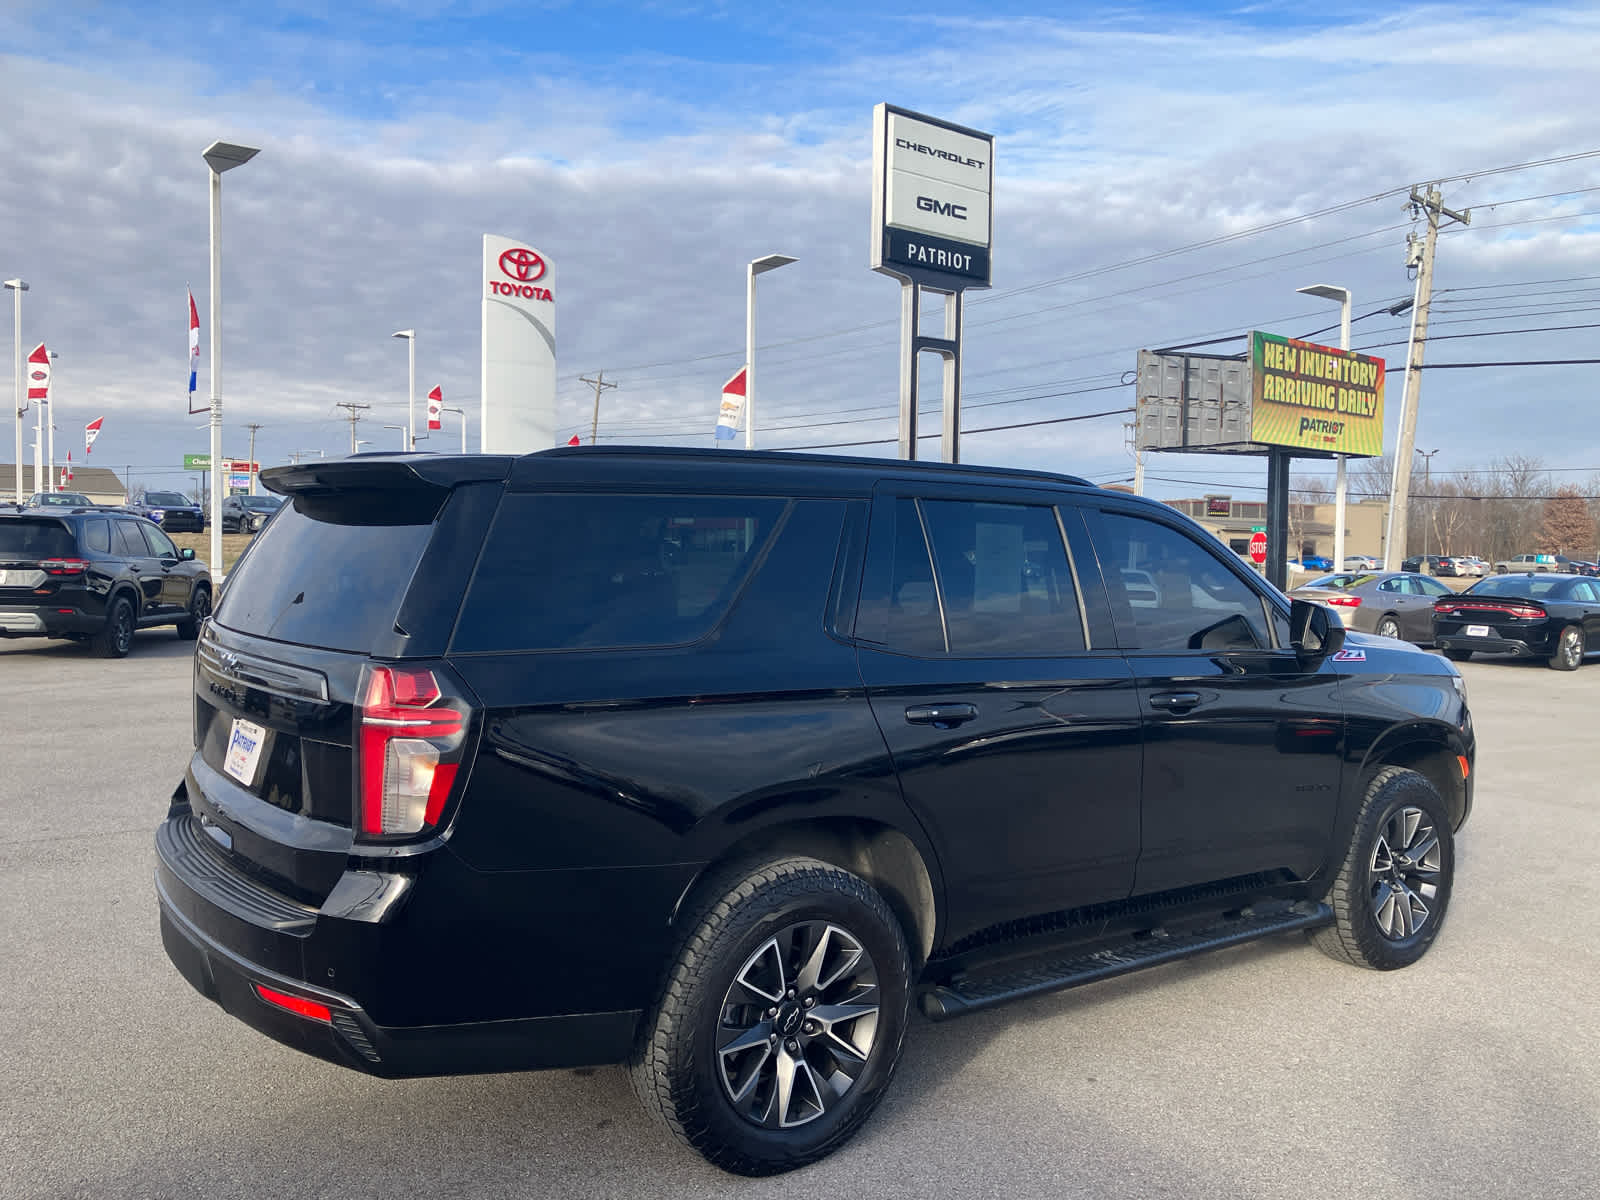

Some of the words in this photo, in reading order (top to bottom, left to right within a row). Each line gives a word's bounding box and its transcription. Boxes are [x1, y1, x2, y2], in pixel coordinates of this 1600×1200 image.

[895, 138, 985, 169] CHEVROLET
[916, 196, 968, 220] GMC
[908, 243, 972, 271] PATRIOT
[489, 281, 553, 302] TOYOTA
[1264, 342, 1297, 373] NEW
[1300, 349, 1377, 387] INVENTORY
[1263, 374, 1335, 409] ARRIVING
[1338, 388, 1376, 416] DAILY
[1299, 416, 1345, 436] PATRIOT
[231, 729, 256, 753] PATRIOT
